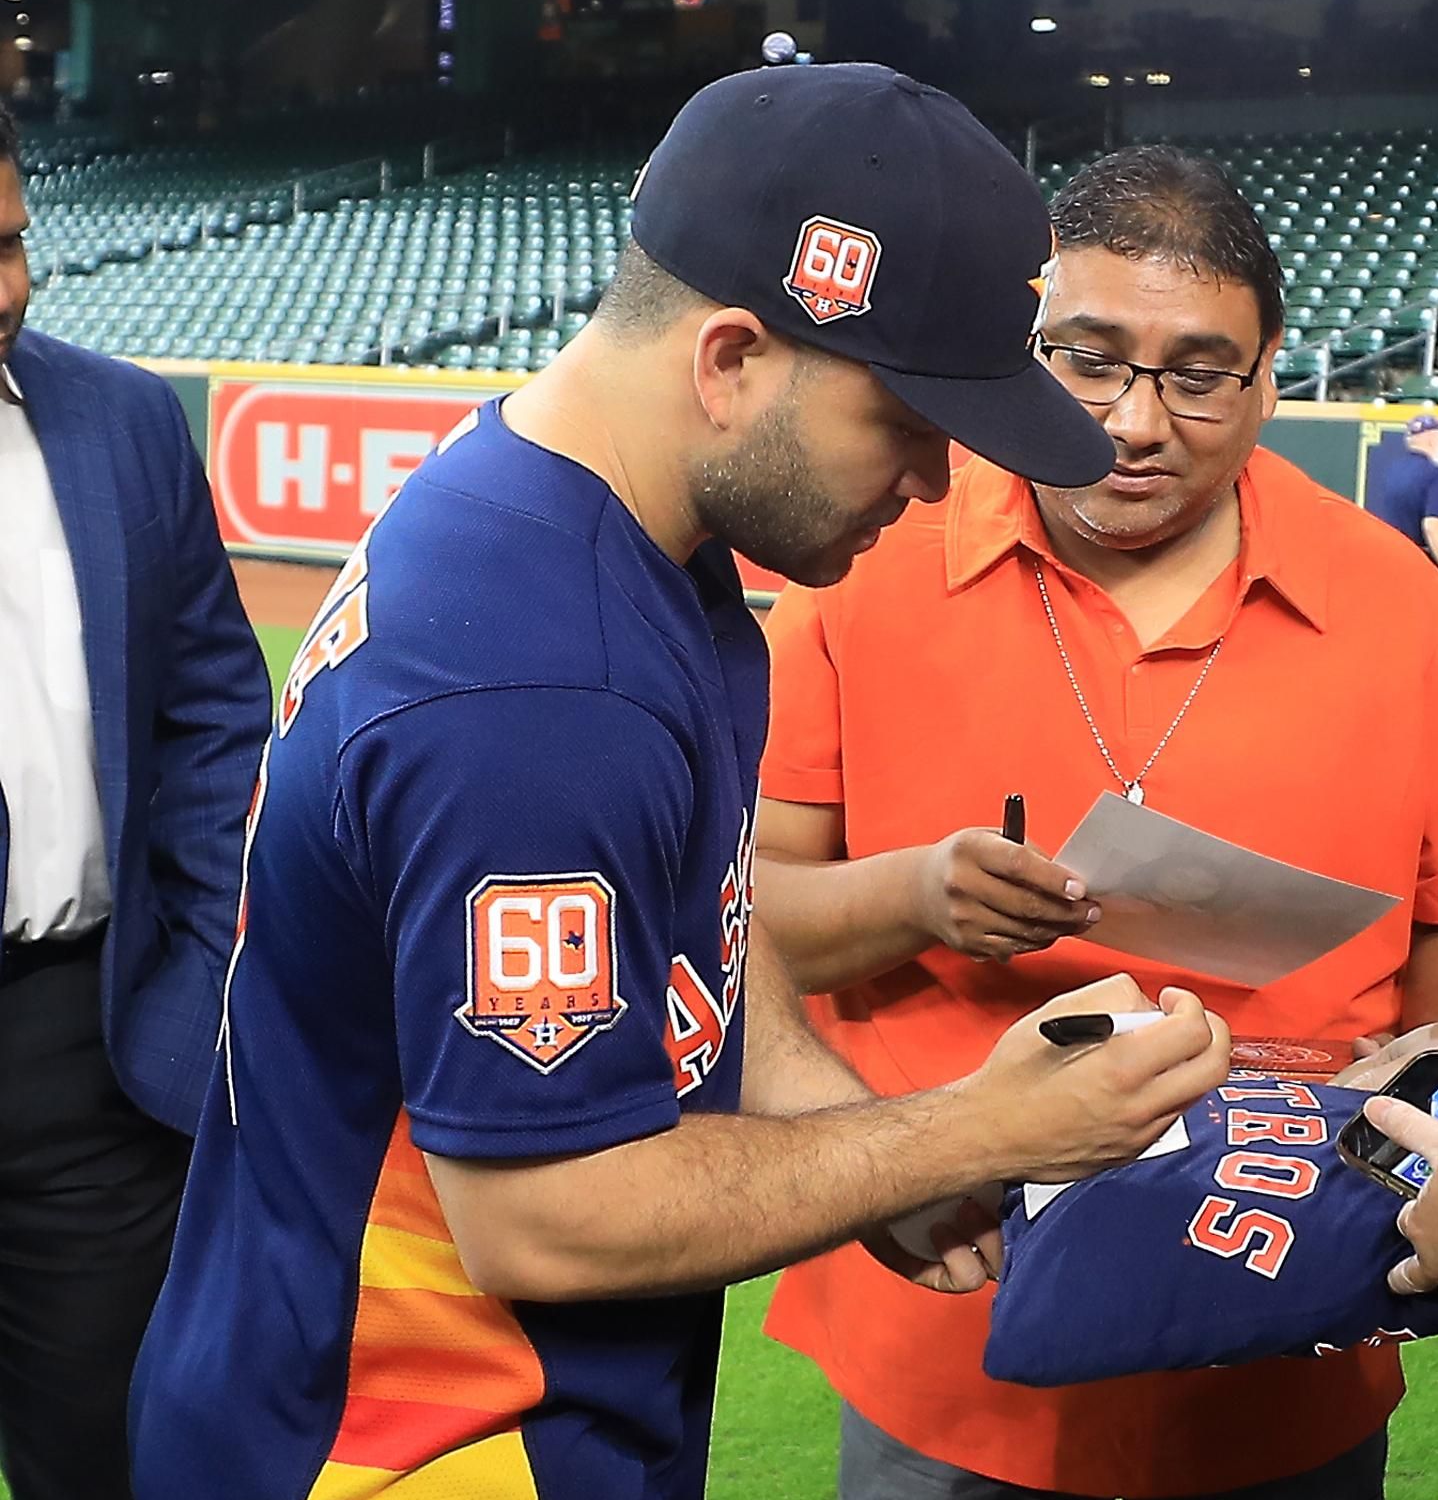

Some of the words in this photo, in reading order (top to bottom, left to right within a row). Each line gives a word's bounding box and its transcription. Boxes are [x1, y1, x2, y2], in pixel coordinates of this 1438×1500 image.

[802, 227, 872, 290] 60
[255, 421, 438, 516] H-E
[487, 894, 599, 992] 60
[488, 992, 600, 1013] YEARS
